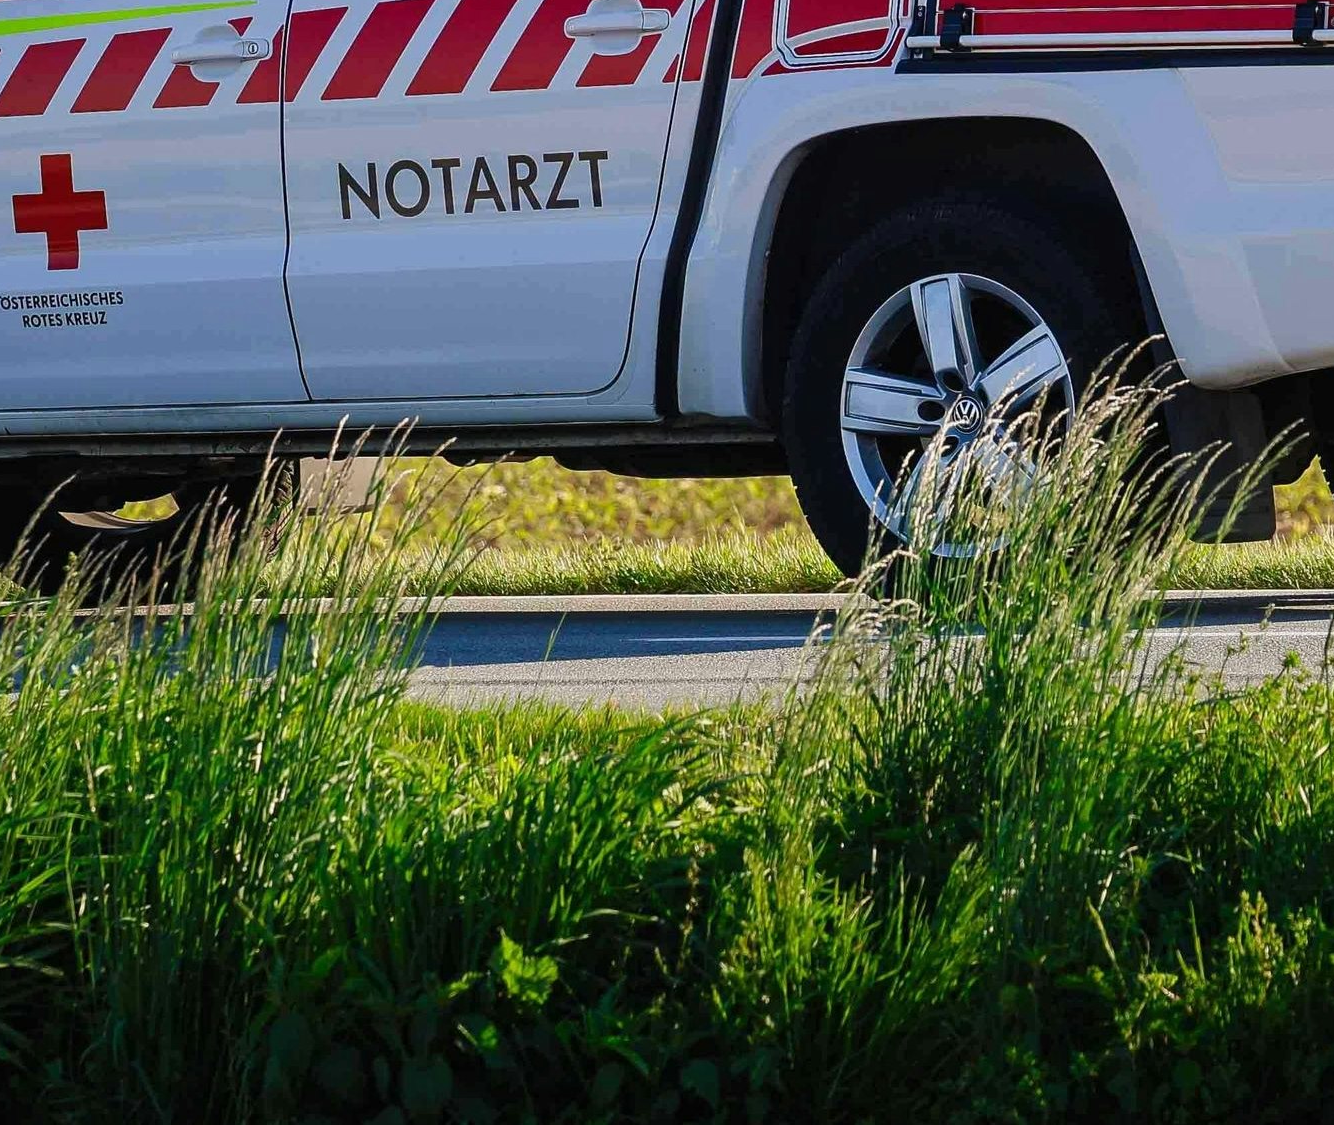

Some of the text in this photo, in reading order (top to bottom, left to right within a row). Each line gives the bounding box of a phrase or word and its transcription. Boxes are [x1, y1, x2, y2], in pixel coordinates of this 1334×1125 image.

[338, 150, 609, 220] NOTARZT
[0, 291, 124, 310] ÖSTERREICHISCHES
[22, 311, 107, 328] ROTES KREUZ
